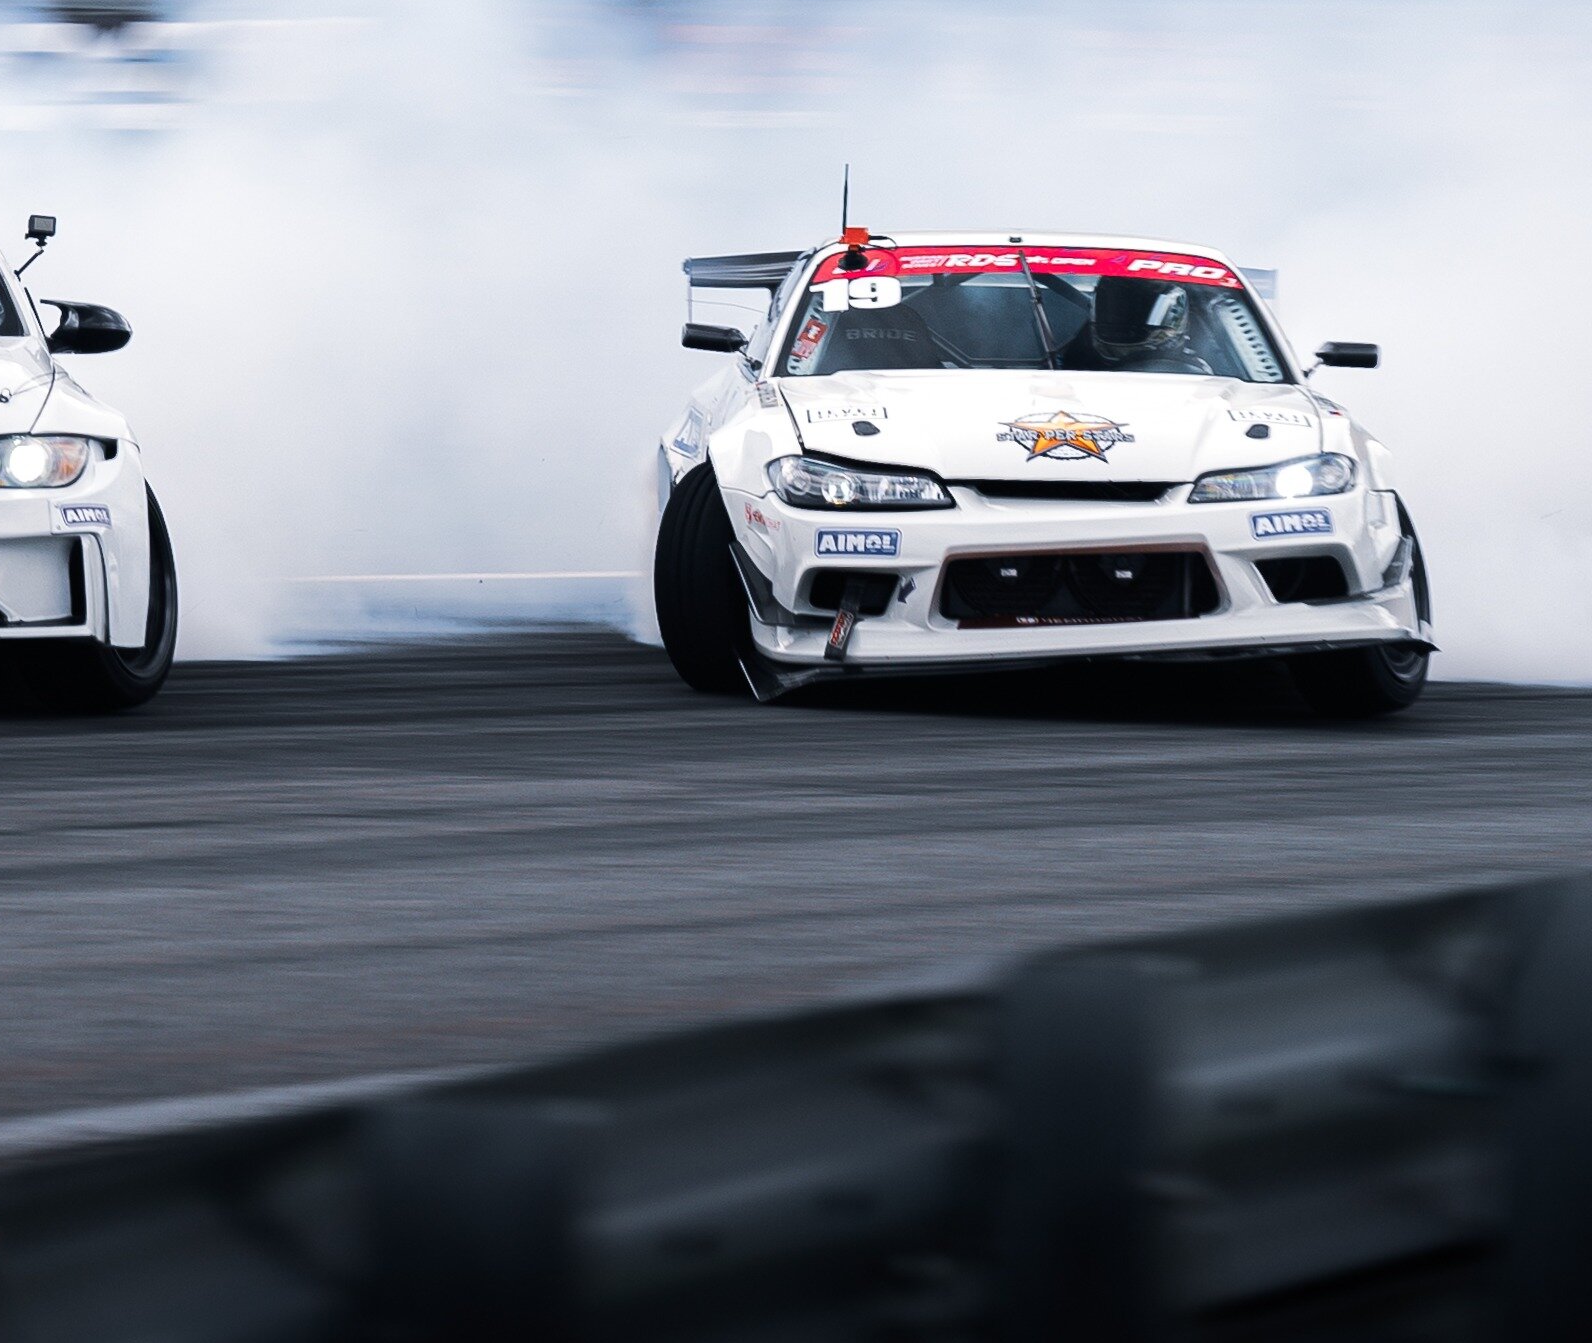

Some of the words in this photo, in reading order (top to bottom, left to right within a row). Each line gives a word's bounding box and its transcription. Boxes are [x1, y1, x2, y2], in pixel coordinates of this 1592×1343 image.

[945, 254, 1020, 267] RDS
[1127, 259, 1226, 279] PRO
[809, 276, 902, 312] 19
[846, 328, 918, 342] BRIDE
[1255, 513, 1330, 535] AIMOL
[819, 534, 895, 552] AIMOL
